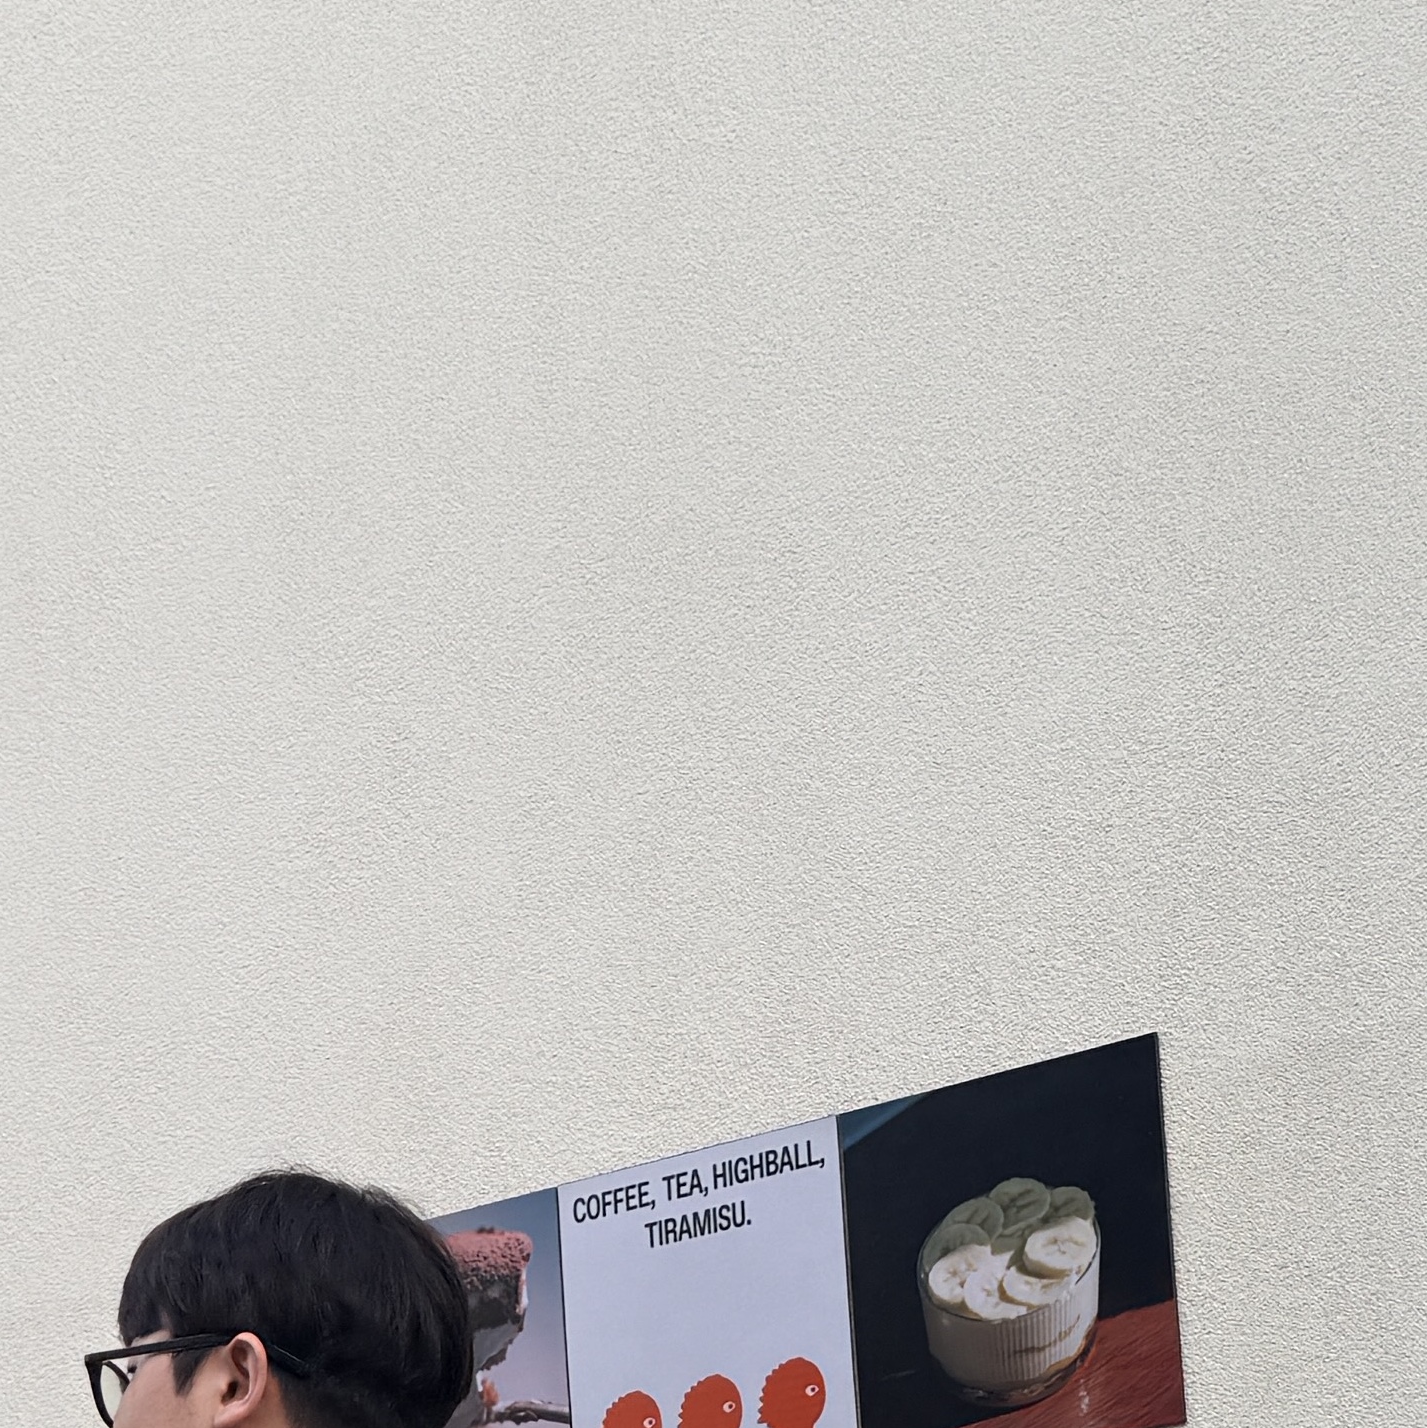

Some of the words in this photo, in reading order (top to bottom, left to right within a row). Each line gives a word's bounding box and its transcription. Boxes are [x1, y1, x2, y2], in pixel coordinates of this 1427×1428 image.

[572, 1181, 656, 1223] COFFEE,
[662, 1168, 709, 1201] TEA,
[712, 1139, 826, 1191] HIGHBALL,
[644, 1200, 752, 1249] TIRAMISU.
